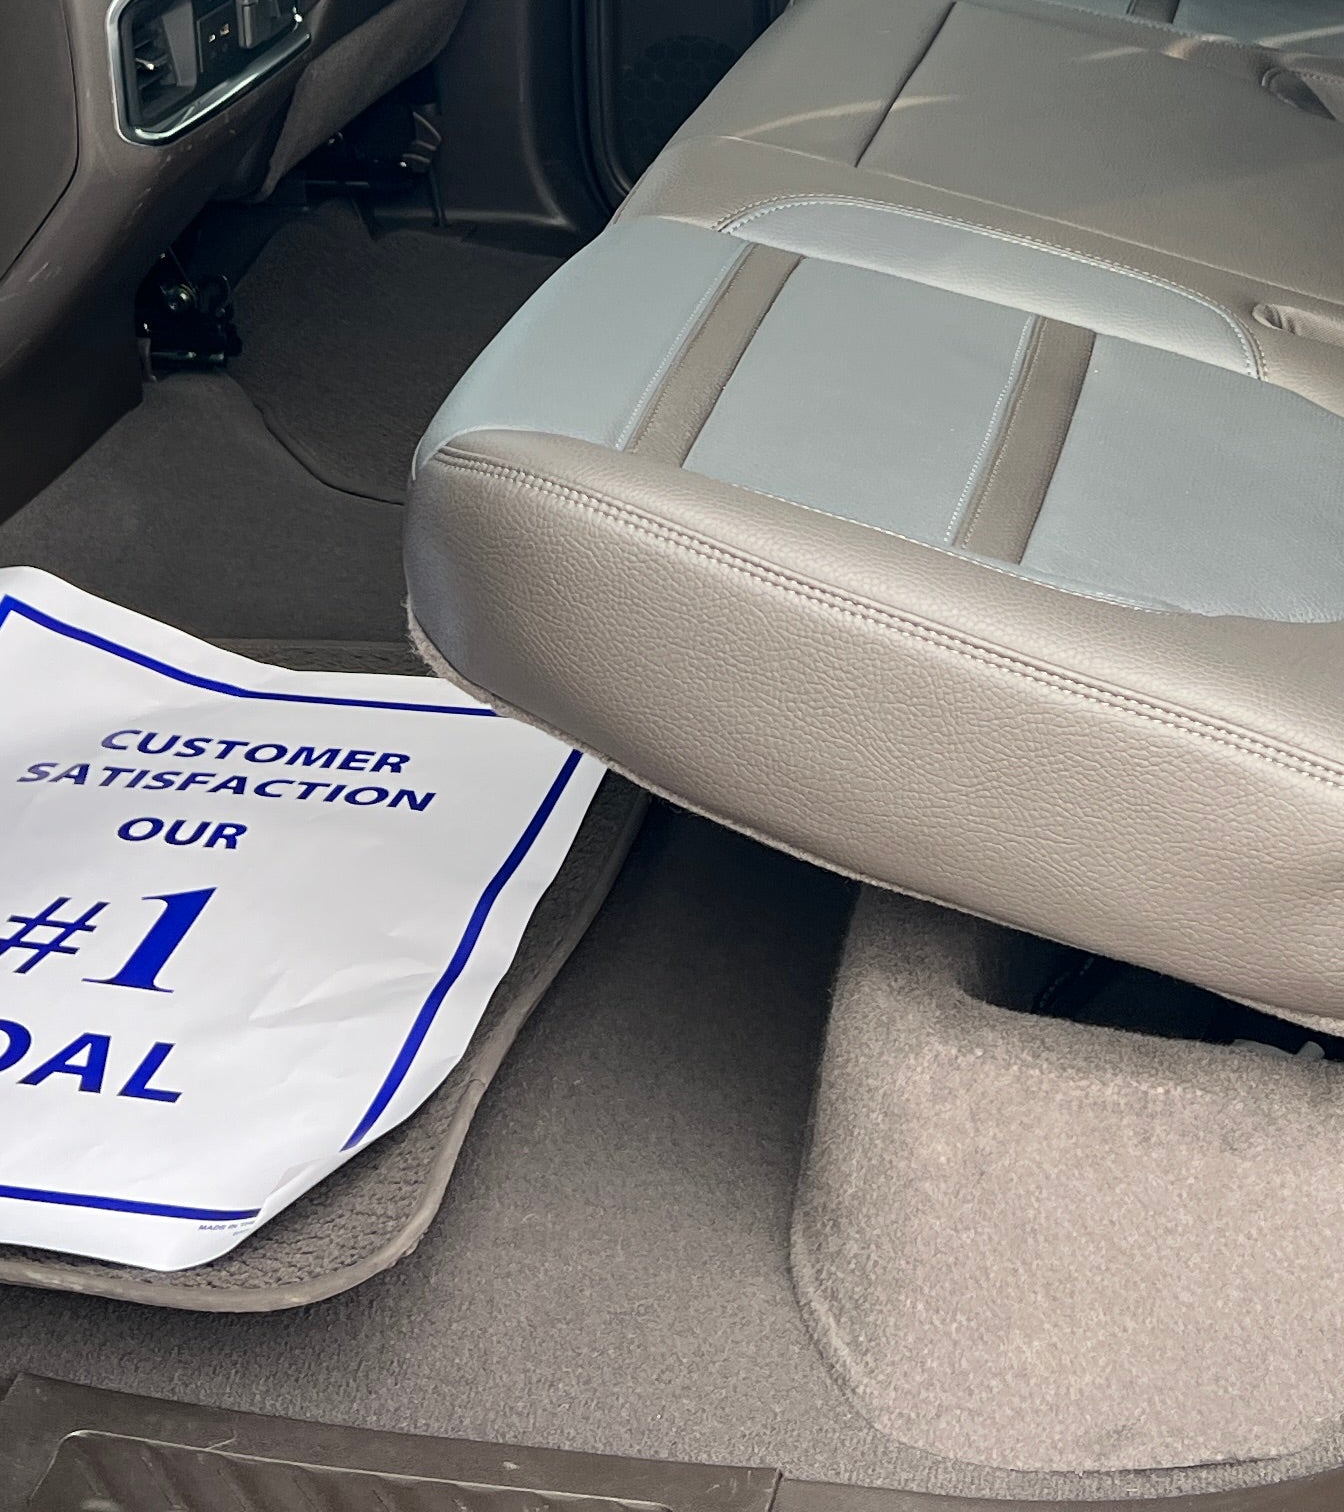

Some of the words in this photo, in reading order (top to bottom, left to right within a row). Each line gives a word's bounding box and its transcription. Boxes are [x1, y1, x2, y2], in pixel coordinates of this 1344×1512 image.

[101, 730, 411, 774] CUSTOMER
[16, 762, 437, 811] SATISFACTION
[116, 817, 248, 849] OUR
